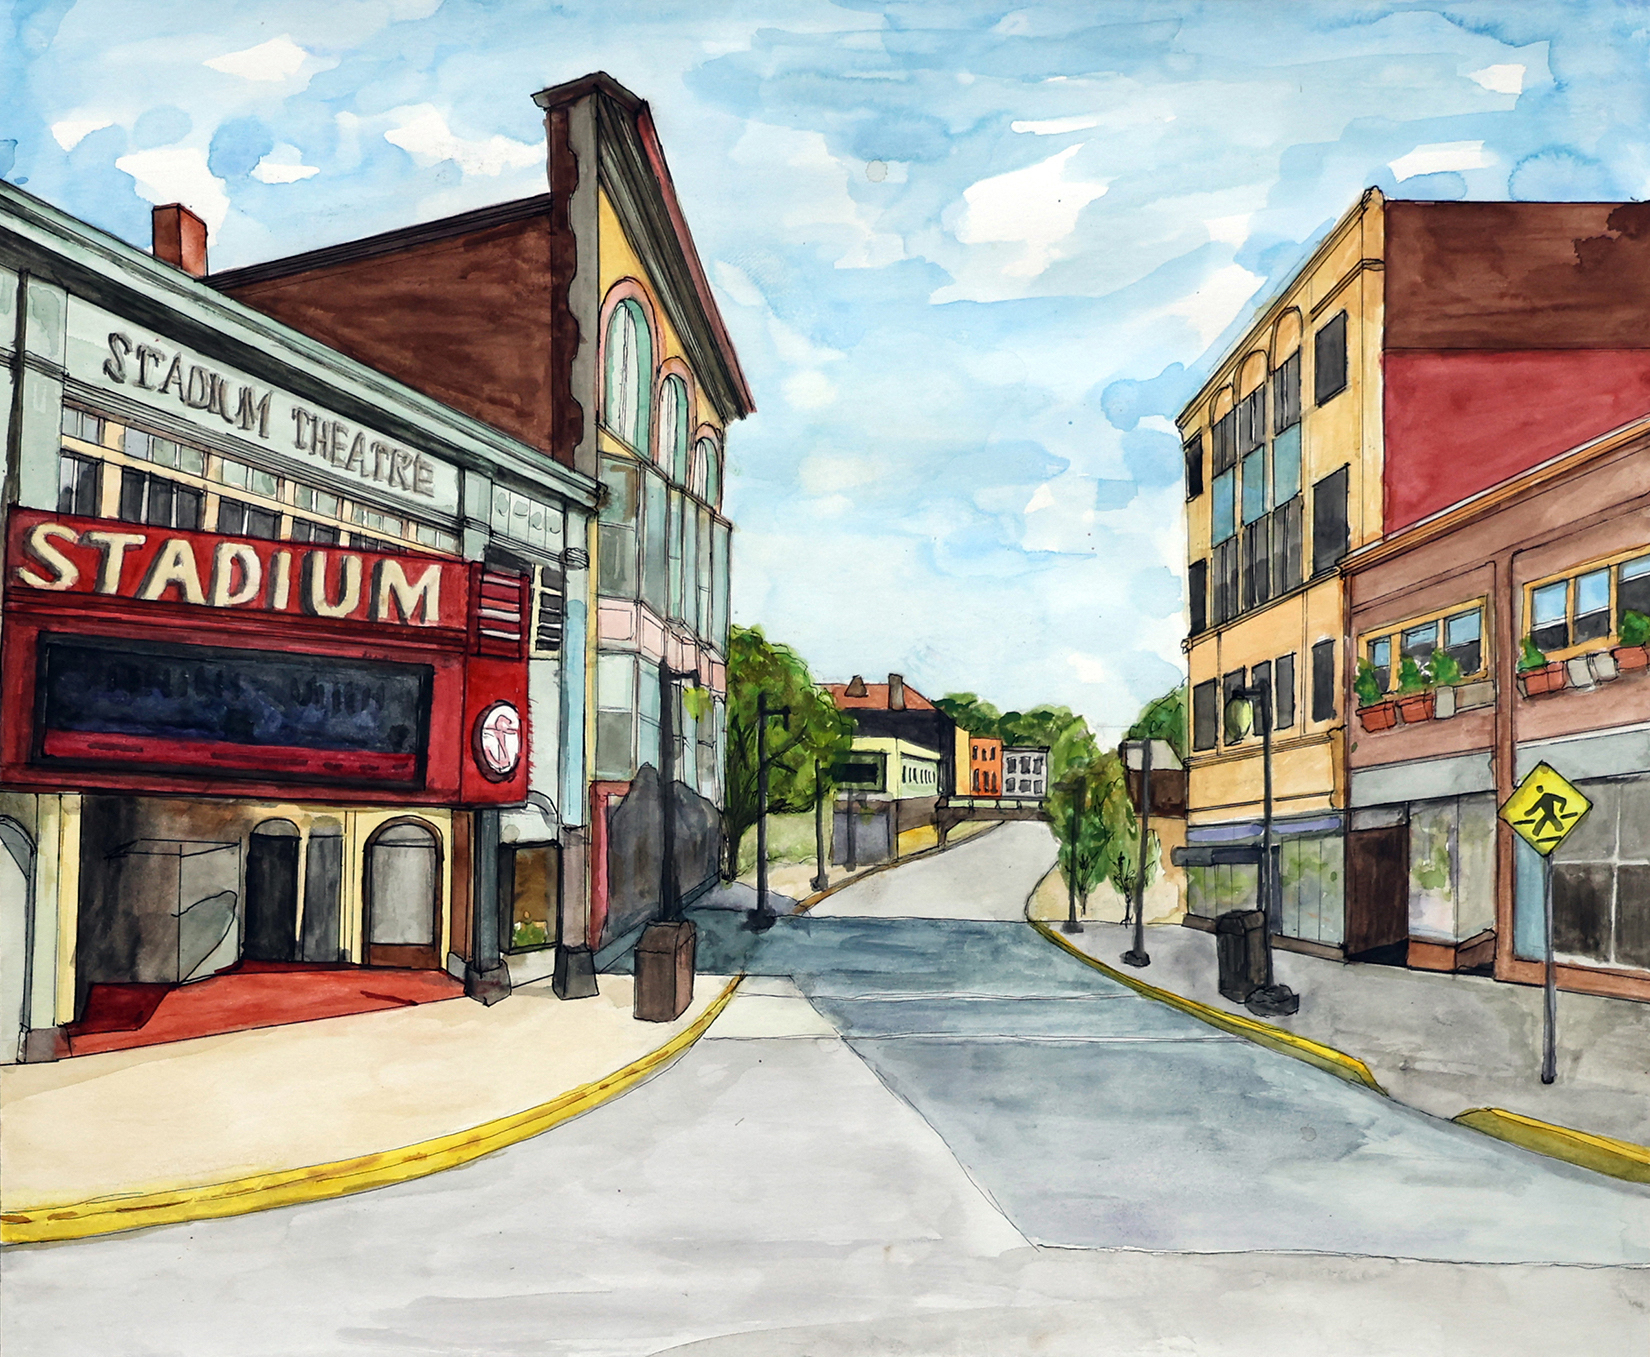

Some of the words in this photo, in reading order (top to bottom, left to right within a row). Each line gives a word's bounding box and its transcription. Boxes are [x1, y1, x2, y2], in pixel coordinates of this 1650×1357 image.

[103, 332, 273, 439] STADIUM
[291, 405, 435, 498] THEATRE
[17, 521, 443, 628] STADIUM
